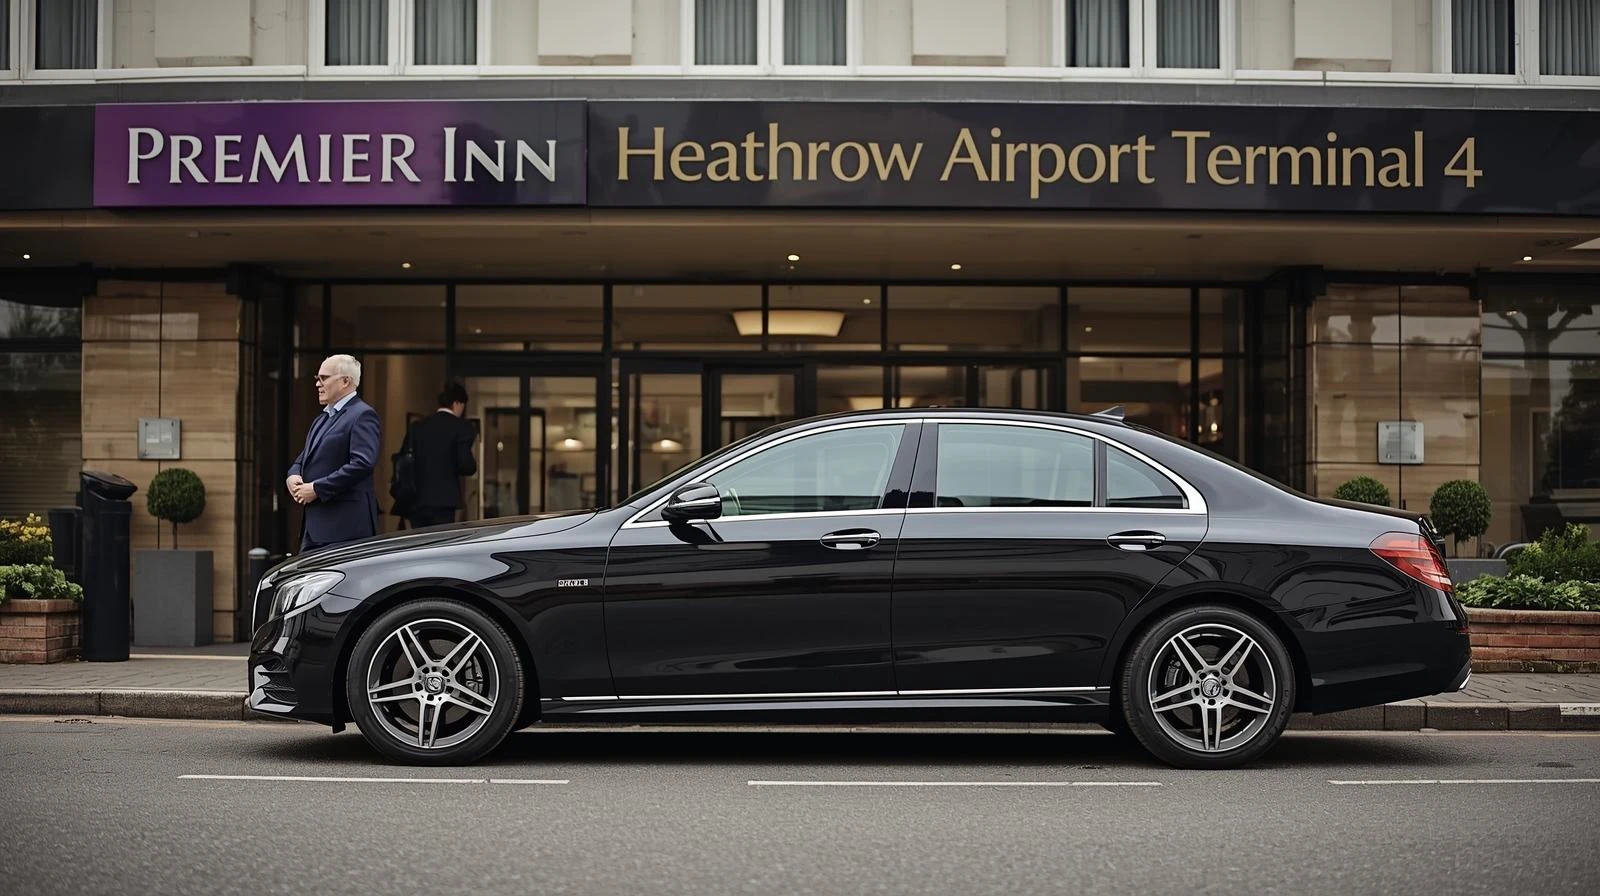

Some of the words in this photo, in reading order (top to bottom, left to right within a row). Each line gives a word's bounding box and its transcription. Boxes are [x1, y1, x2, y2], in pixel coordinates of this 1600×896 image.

[127, 127, 421, 184] PREMIER
[443, 127, 557, 183] INN
[618, 122, 922, 182] Heathrow
[941, 127, 1154, 200] Airport
[1172, 130, 1424, 188] Terminal
[1444, 138, 1483, 188] 4
